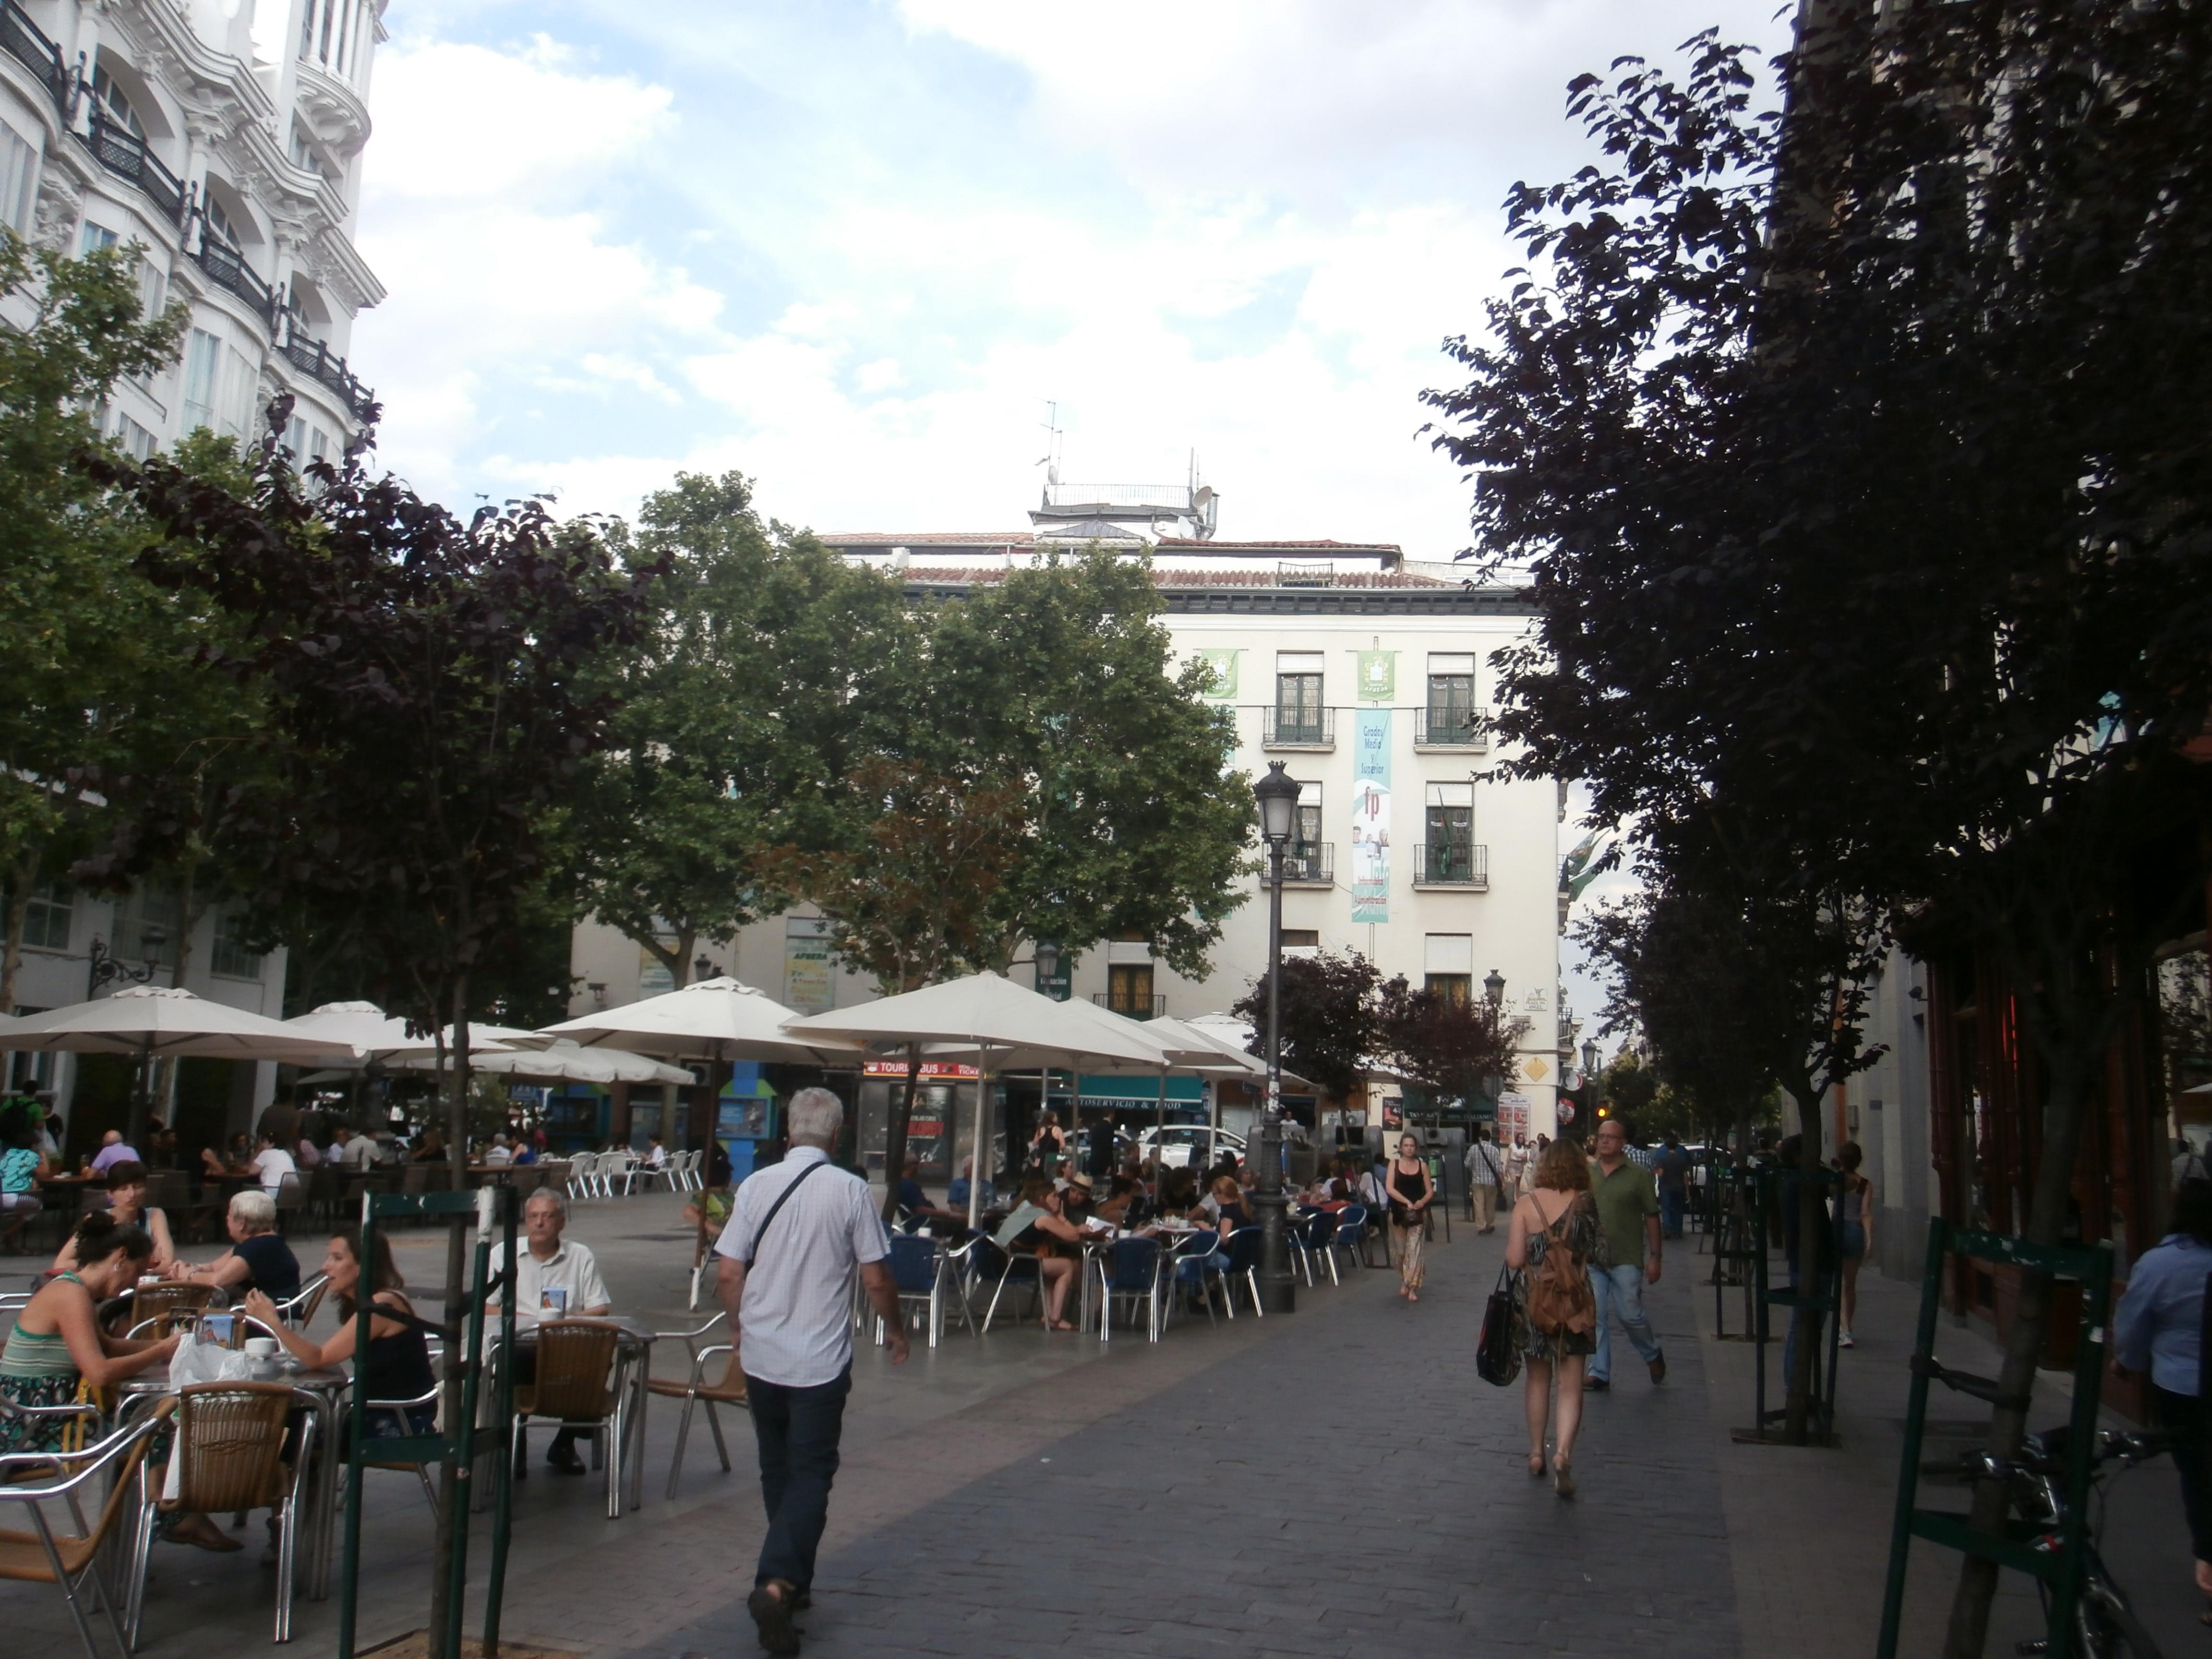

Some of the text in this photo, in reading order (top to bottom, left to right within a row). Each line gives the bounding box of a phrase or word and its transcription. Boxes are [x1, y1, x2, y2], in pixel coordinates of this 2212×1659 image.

[1363, 725, 1383, 737] Grados
[1364, 738, 1382, 749] Medio
[1361, 763, 1384, 775] Superior
[1364, 786, 1380, 821] fp
[1065, 1098, 1135, 1108] ATOSERVICIO
[1141, 1100, 1150, 1108] &
